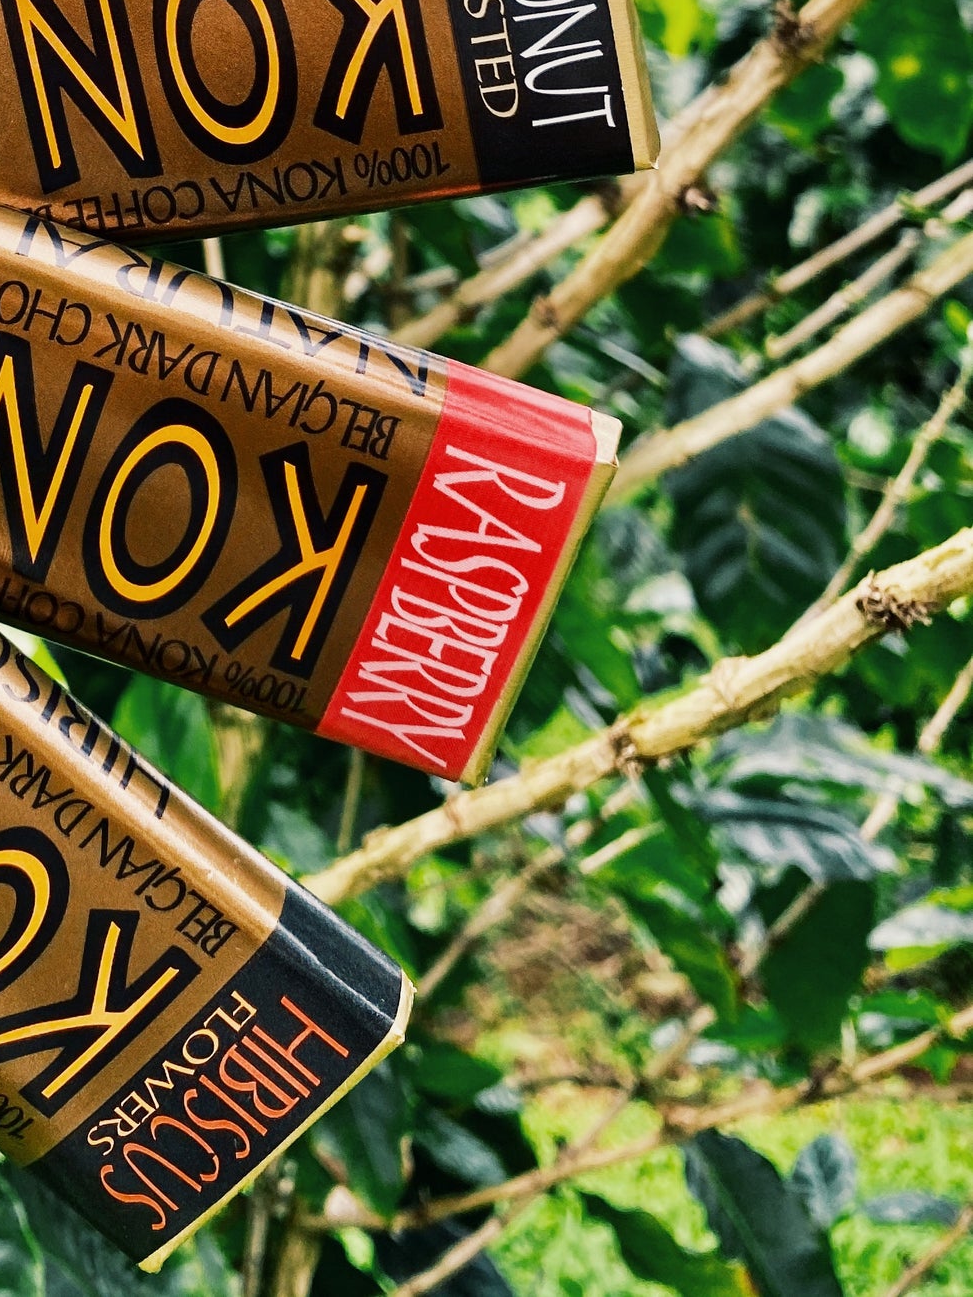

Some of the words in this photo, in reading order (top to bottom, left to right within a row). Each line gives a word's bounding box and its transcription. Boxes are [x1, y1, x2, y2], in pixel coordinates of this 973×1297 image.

[62, 178, 206, 233] COFFEE
[214, 157, 347, 213] KONA
[354, 141, 451, 188] 100%
[94, 313, 221, 396] DARK
[223, 371, 402, 460] BELGIAN
[340, 444, 567, 769] RASPBERRY
[96, 611, 220, 686] KONA
[226, 662, 310, 714] 100%
[79, 818, 239, 958] BELGIAN
[87, 991, 257, 1156] FLOWERS
[100, 996, 349, 1230] HIBISCUS
